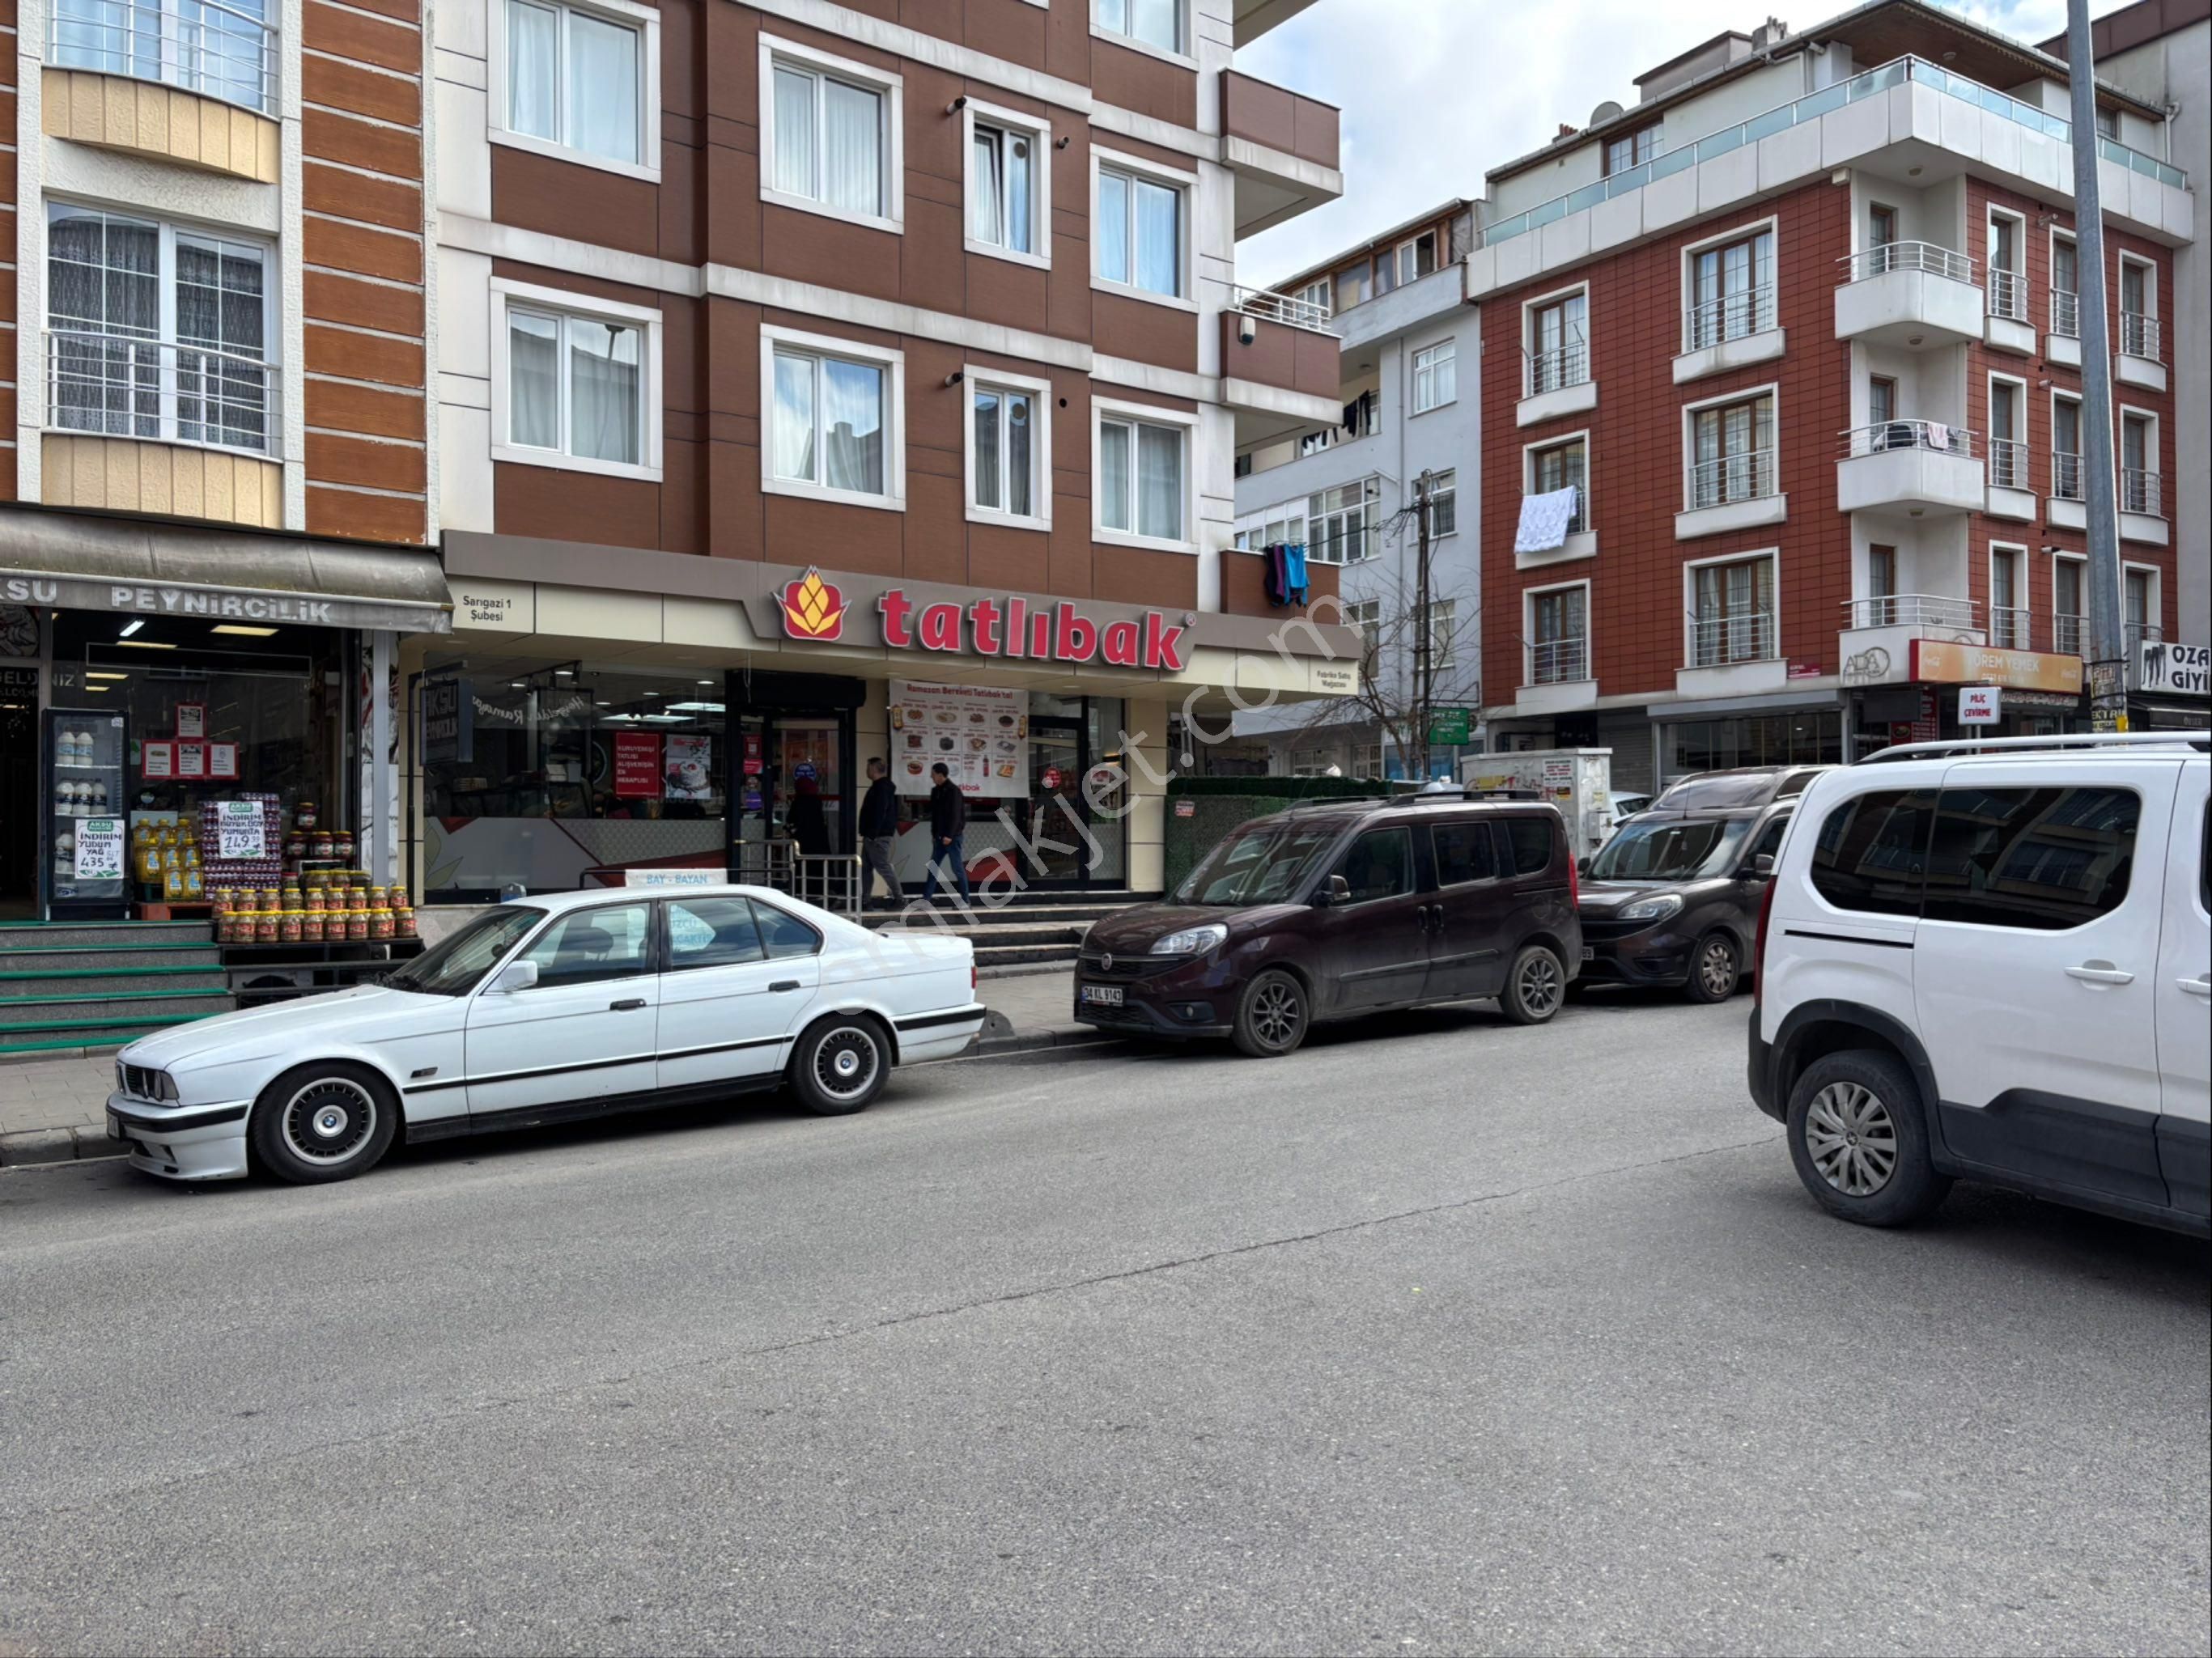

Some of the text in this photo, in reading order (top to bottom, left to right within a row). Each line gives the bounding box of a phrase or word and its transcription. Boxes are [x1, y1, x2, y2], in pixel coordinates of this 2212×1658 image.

[463, 596, 512, 608] Sarıgazi 1
[470, 609, 503, 621] Şubesi
[877, 587, 1185, 672] tatlıbak
[81, 857, 104, 867] 435
[647, 874, 664, 884] BAY
